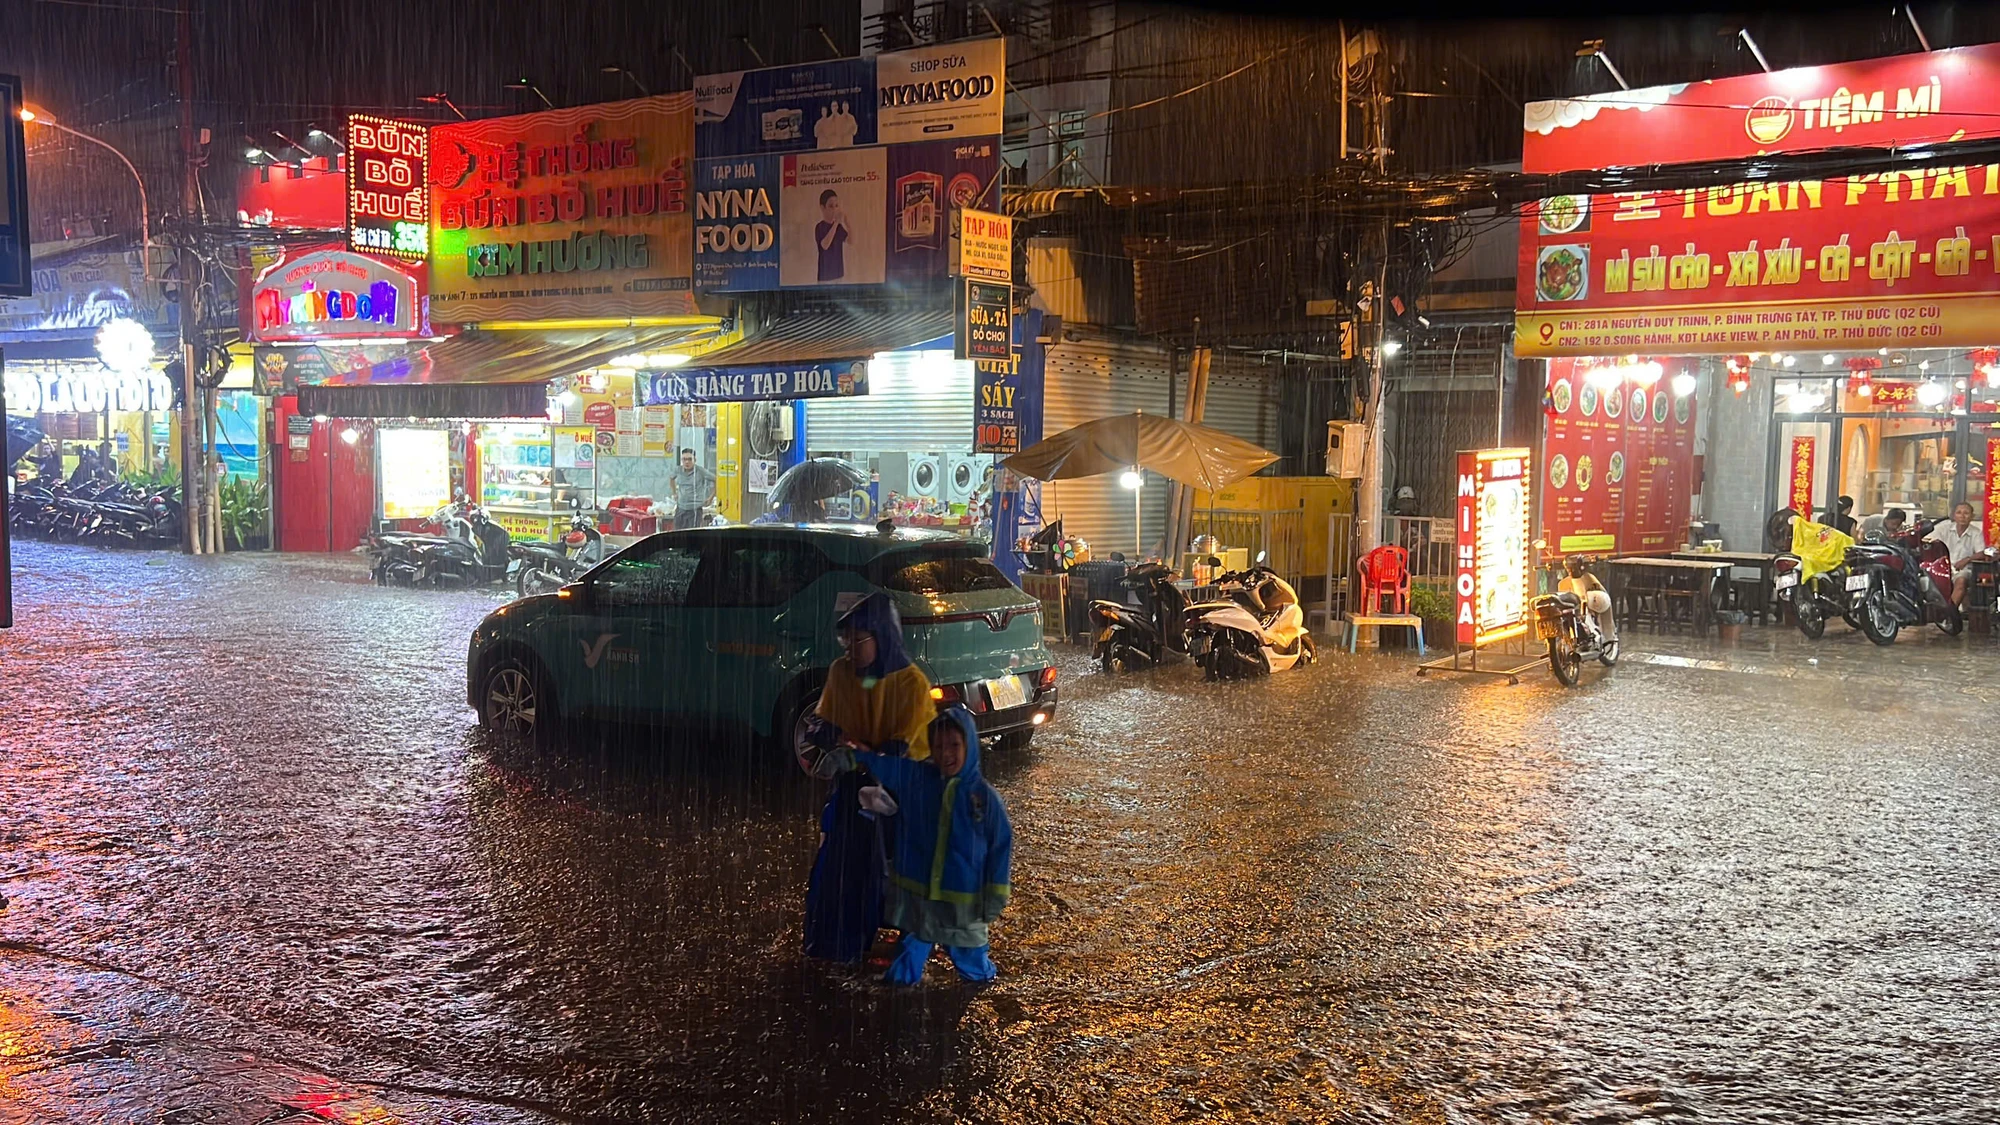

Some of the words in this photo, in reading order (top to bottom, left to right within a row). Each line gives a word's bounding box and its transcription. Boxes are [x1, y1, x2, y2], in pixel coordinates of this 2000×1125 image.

[910, 58, 940, 73] SHOP
[942, 54, 967, 69] SỮA
[880, 74, 996, 108] NYNAFOOD
[1799, 86, 1885, 133] TIỆM
[1896, 75, 1942, 120] MÌ
[528, 120, 636, 177] THỐNG
[364, 158, 412, 187] BÒ
[711, 165, 732, 185] TẠP
[734, 161, 756, 179] HÓA
[354, 187, 423, 221] HUẾ
[530, 181, 586, 226] BÒ
[596, 157, 688, 219] HUẾ
[696, 187, 774, 220] NYNA
[696, 222, 774, 254] FOOD
[964, 216, 985, 238] TẠP
[988, 218, 1009, 240] HÓA
[467, 240, 523, 279] KIM
[529, 231, 650, 275] HƯƠNG
[1604, 248, 1630, 293] MÌ
[1631, 244, 1667, 292] SỦI
[1669, 242, 1711, 290] CẢO
[1725, 239, 1760, 288] XÁ
[1761, 237, 1803, 285] XÍU
[1819, 233, 1851, 282] CÁ
[1869, 230, 1917, 287] CẬT
[1934, 226, 1971, 276] GÀ
[994, 309, 1008, 327] TÃ
[1559, 320, 1582, 333] CN1:
[1584, 318, 1609, 331] 281A
[1611, 315, 1652, 330] NGUYỄN
[1654, 316, 1675, 328] DUY
[1714, 314, 1724, 325] P.
[1727, 312, 1753, 325] BÌNH
[1756, 310, 1793, 324] TRƯNG
[1822, 309, 1838, 322] TP.
[1841, 305, 1864, 321] THỦ
[1866, 306, 1891, 320] ĐỨC
[1895, 306, 1916, 320] (Q2
[1919, 304, 1941, 319] CŨ)
[973, 326, 985, 341] ĐỒ
[985, 329, 1006, 343] CHƠI
[1558, 336, 1581, 347] CN2:
[1584, 335, 1602, 346] 192
[1677, 332, 1698, 343] KĐT
[1700, 331, 1728, 343] LAKE
[1762, 329, 1772, 341] P.
[1774, 329, 1791, 341] AN
[1823, 327, 1839, 340] TP.
[1841, 323, 1865, 339] THỦ
[1867, 324, 1893, 338] ĐỨC
[1896, 324, 1918, 338] (Q2
[1920, 321, 1943, 338] CŨ)
[655, 371, 691, 399] CỬA
[695, 369, 745, 397] HÀNG
[751, 373, 789, 399] TẠP
[793, 363, 835, 392] HÓA
[980, 378, 1016, 409] SẤY
[981, 410, 988, 418] 3
[990, 410, 1014, 420] SẠCH
[976, 425, 1002, 446] 10
[515, 517, 539, 526] THỐNG
